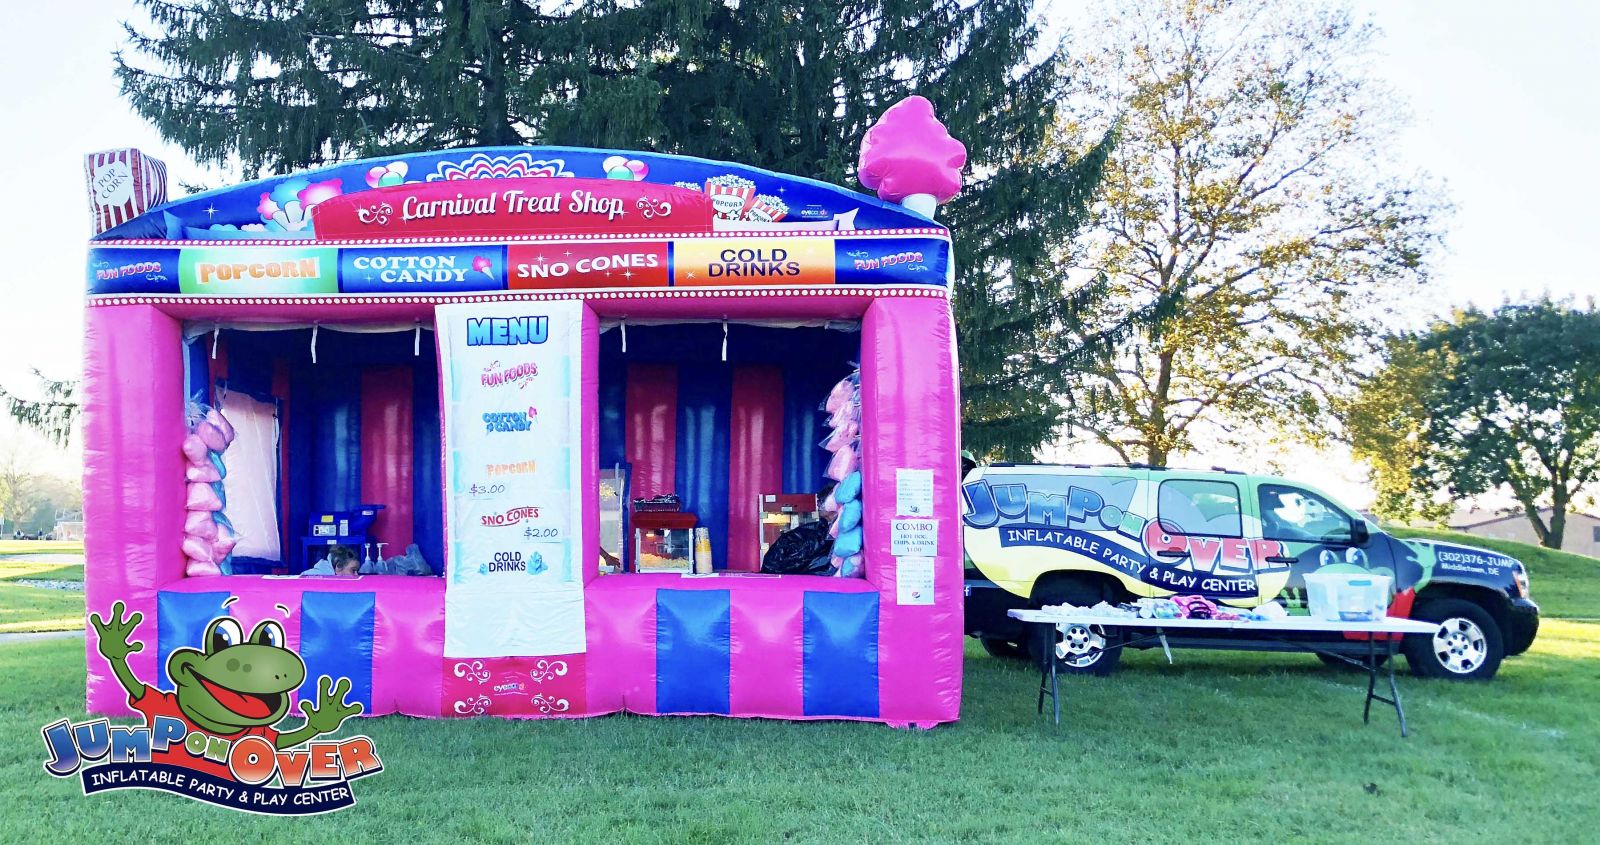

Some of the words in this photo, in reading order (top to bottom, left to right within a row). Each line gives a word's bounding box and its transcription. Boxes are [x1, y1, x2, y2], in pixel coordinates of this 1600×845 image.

[98, 168, 116, 188] POP
[102, 171, 129, 199] CORN
[402, 193, 497, 220] Carnival
[503, 190, 562, 214] Treat
[568, 190, 624, 221] Shop
[353, 256, 456, 269] COTTON
[719, 249, 788, 263] COLD
[854, 258, 879, 271] FUN
[881, 251, 924, 267] FOODS
[96, 268, 118, 280] FUN
[119, 261, 162, 277] FOODS
[200, 260, 317, 284] POPCORN
[517, 262, 569, 278] SNO
[575, 253, 658, 273] CONES
[707, 261, 801, 277] DRINKS
[380, 268, 469, 283] CANDY
[466, 315, 549, 347] MENU
[481, 372, 503, 388] FUN
[504, 362, 538, 384] FOODS
[482, 412, 527, 424] COTTON
[494, 420, 532, 433] CANDY
[487, 461, 537, 477] POPCORN
[469, 483, 505, 496] $3.00
[481, 514, 504, 525] SNO
[506, 508, 539, 523] CONES
[523, 526, 558, 541] $2.00
[962, 479, 1103, 528] JUMP
[1141, 517, 1291, 573] OVER
[494, 551, 521, 563] COLD
[1008, 530, 1098, 554] INFLATABLE
[1103, 547, 1147, 576] PARTY
[1150, 568, 1159, 580] &
[1163, 571, 1197, 588] PLAY
[1201, 578, 1256, 592] CENTER
[1438, 551, 1514, 568] (302)376-JUMP
[488, 561, 526, 572] DRINKS
[1488, 567, 1500, 576] DE
